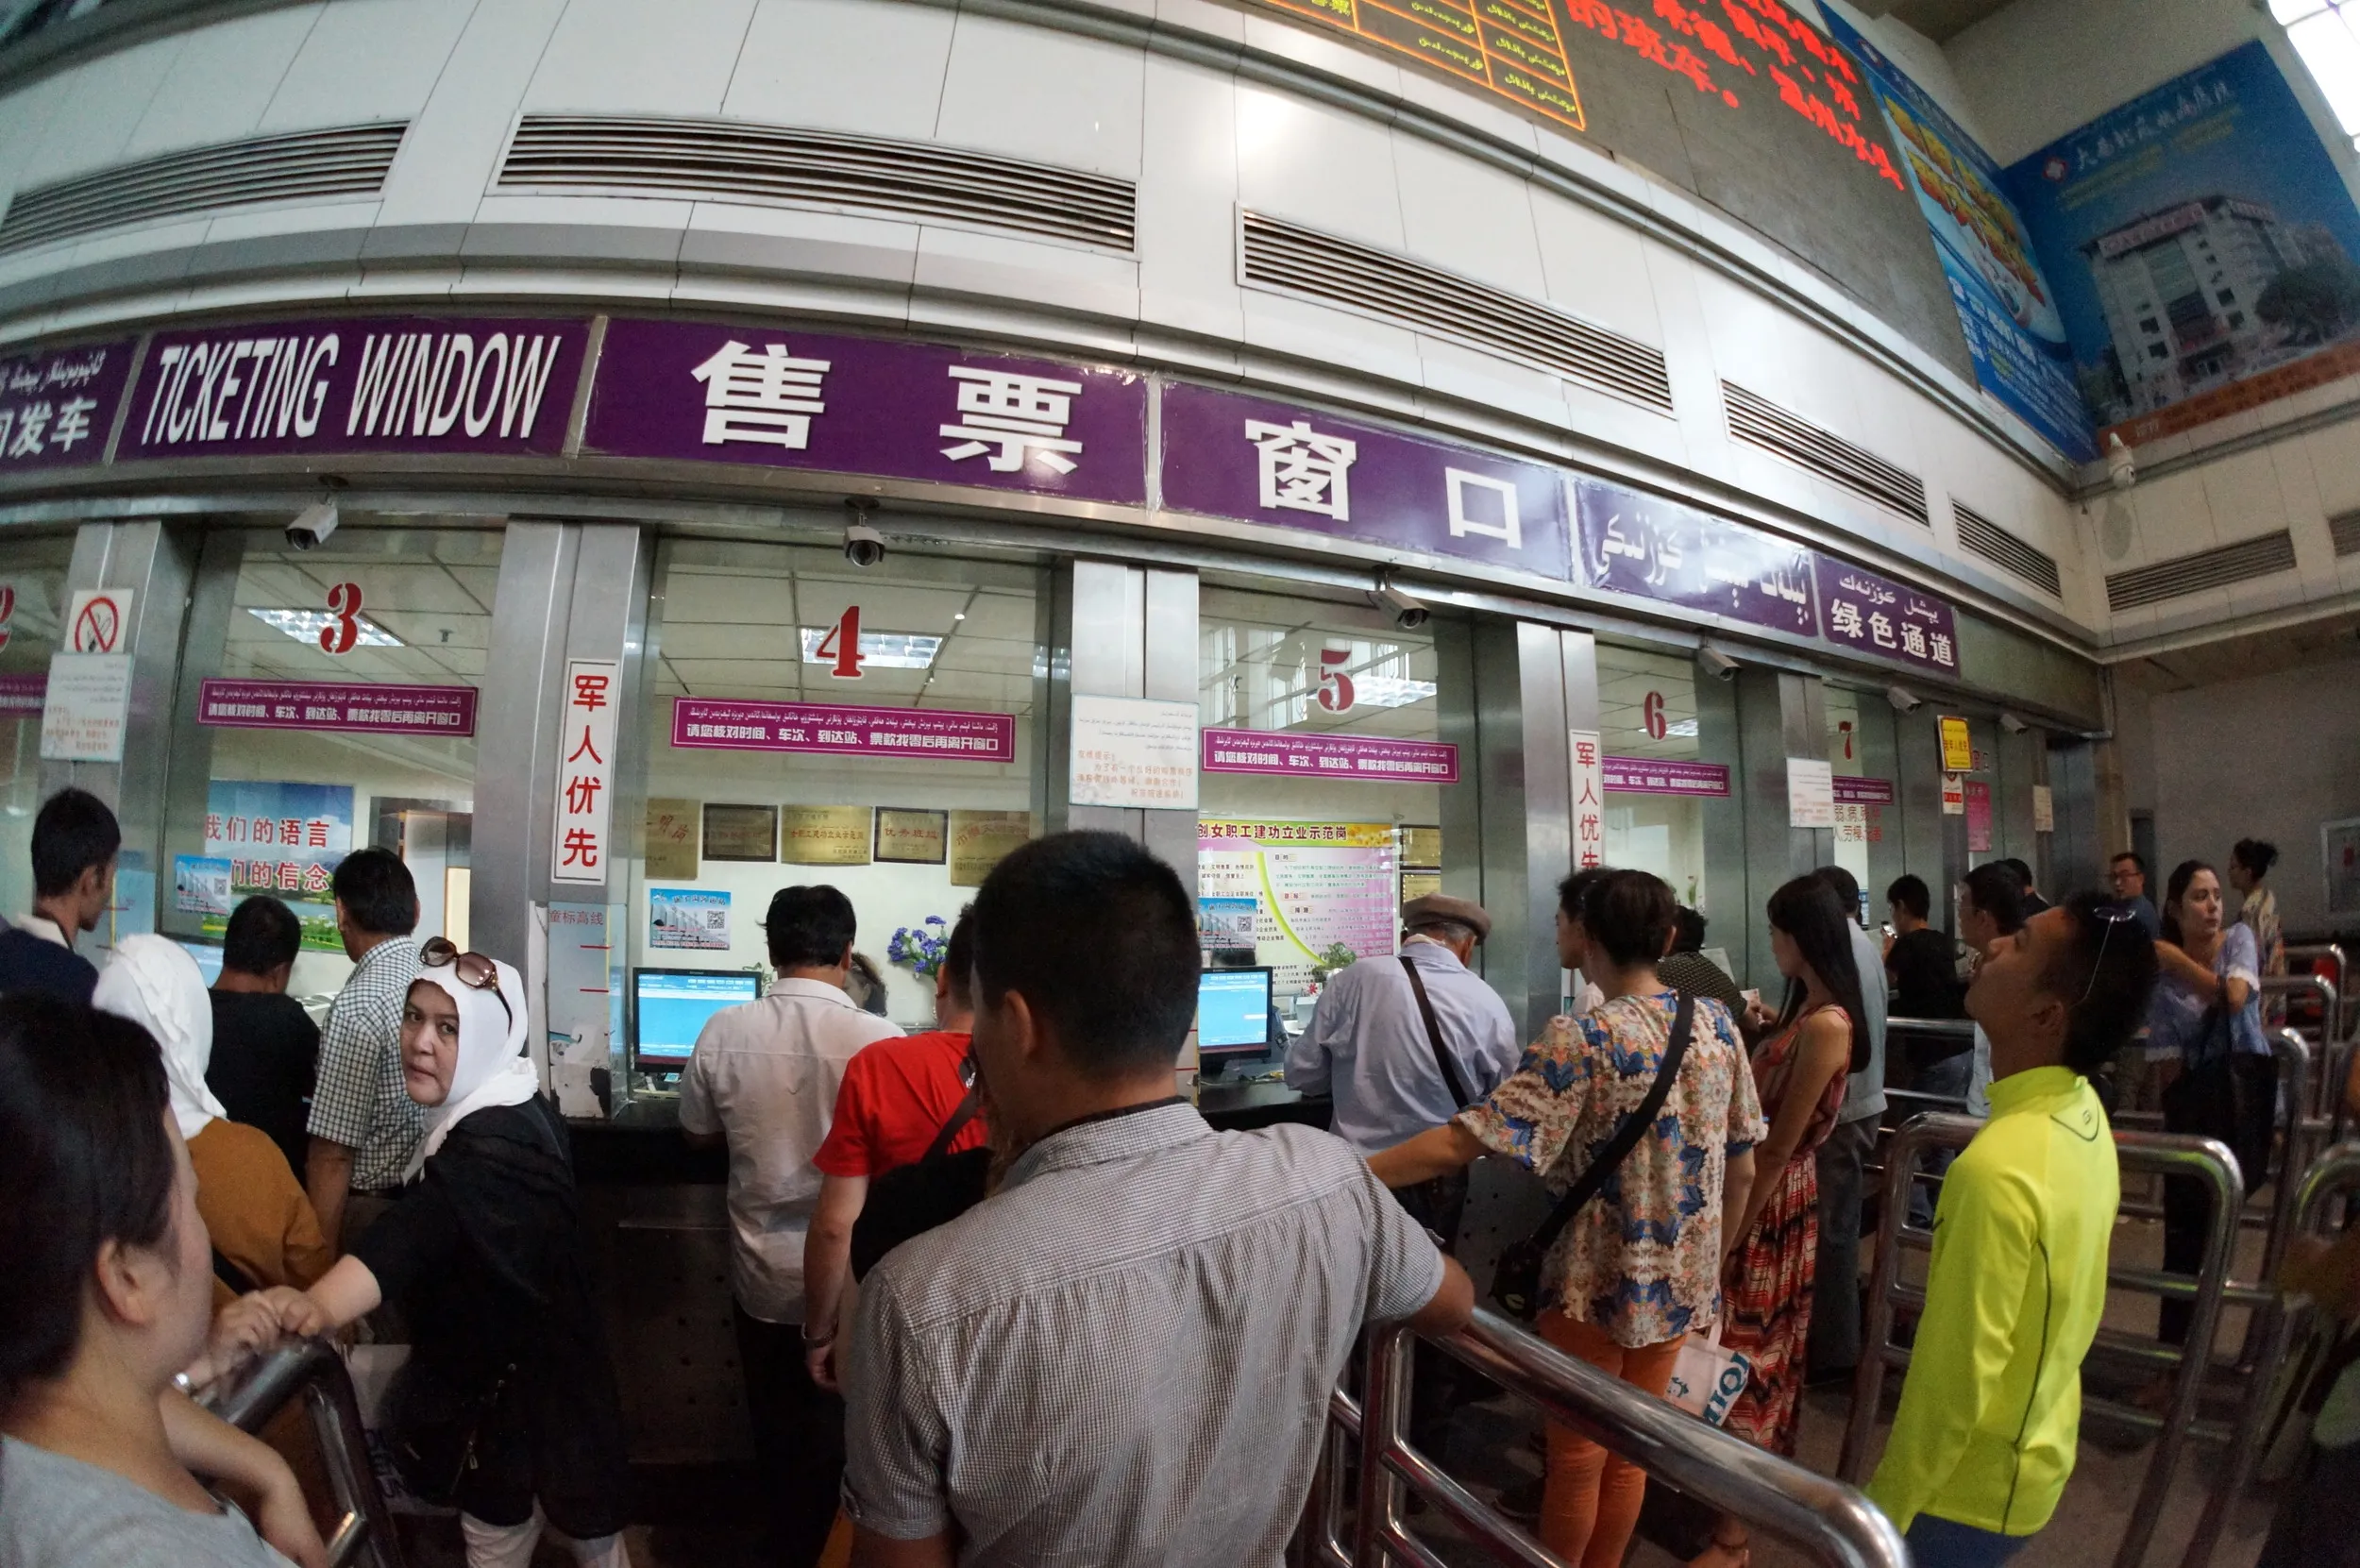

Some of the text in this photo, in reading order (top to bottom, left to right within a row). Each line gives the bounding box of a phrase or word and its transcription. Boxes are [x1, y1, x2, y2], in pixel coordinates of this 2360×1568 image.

[141, 332, 339, 445] TICKETING
[346, 332, 562, 439] WINDOW
[318, 582, 364, 656] 3
[816, 606, 867, 678] 4
[1830, 597, 1955, 668] 绿色通道
[1317, 648, 1356, 715] 5
[1644, 690, 1667, 740] 6
[563, 674, 610, 868] 军人优先
[686, 723, 999, 751] 请您核对时间、车次、到达站、票款找零后再离开窗口
[1838, 720, 1853, 760] 7
[205, 814, 330, 848] 我们的语言
